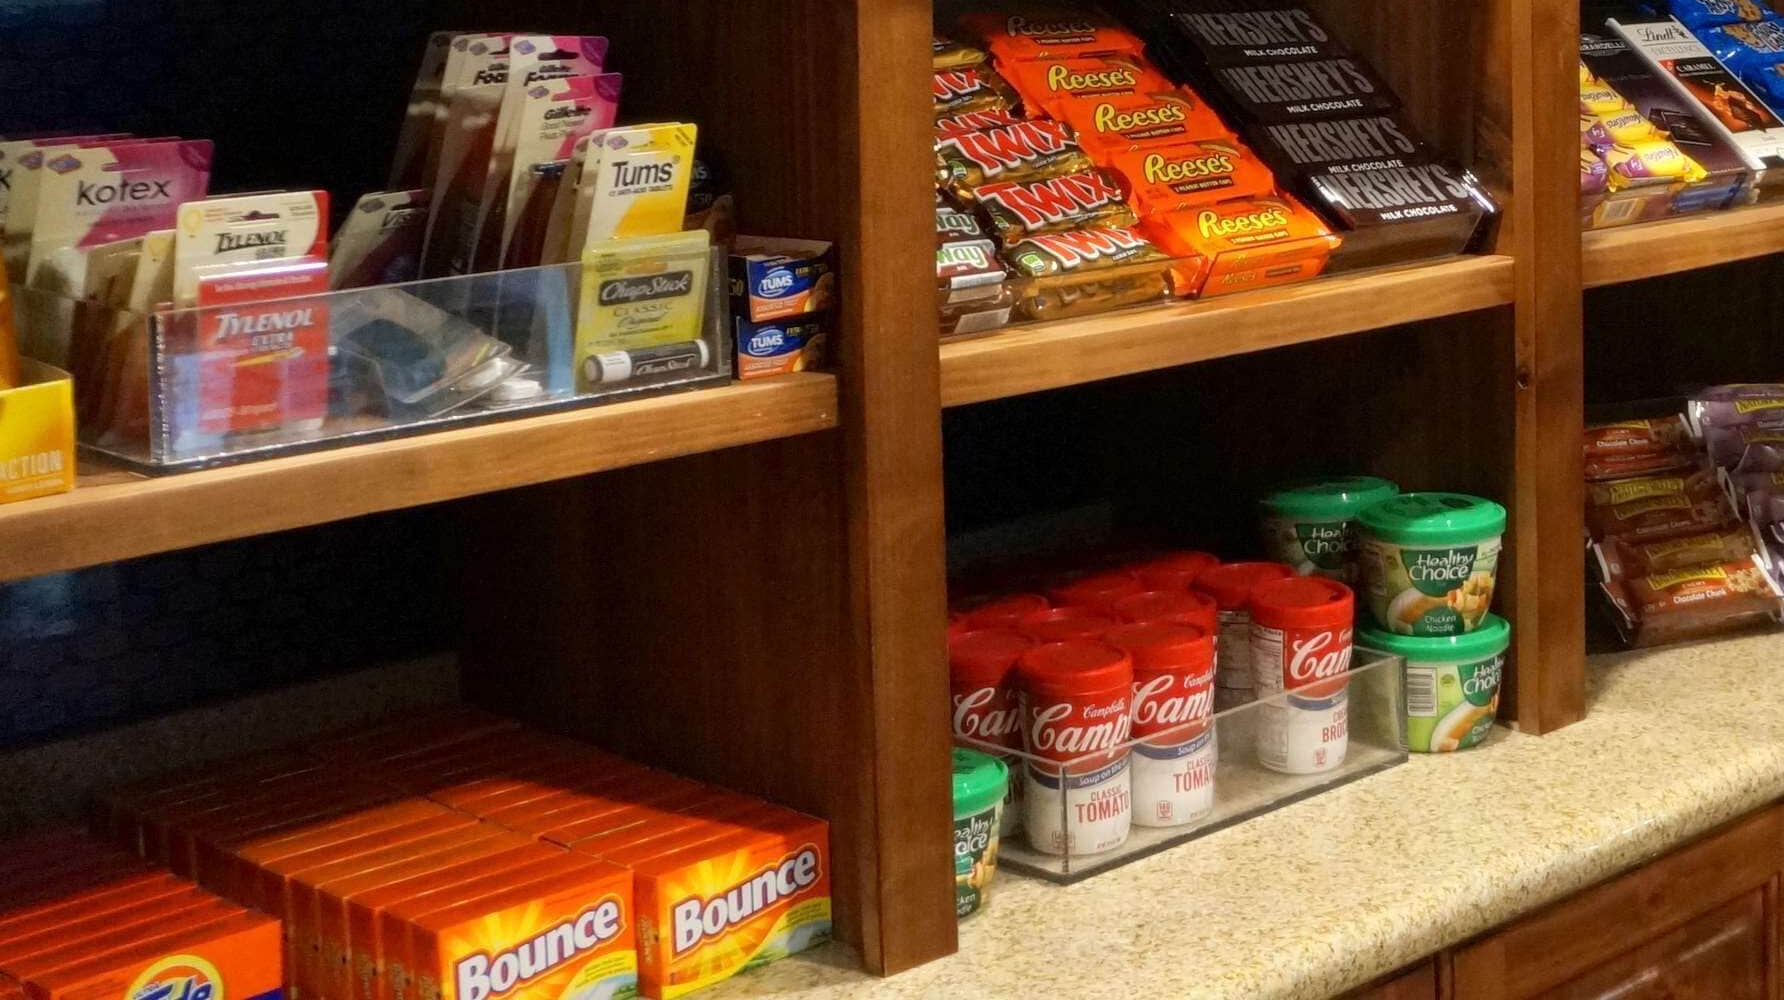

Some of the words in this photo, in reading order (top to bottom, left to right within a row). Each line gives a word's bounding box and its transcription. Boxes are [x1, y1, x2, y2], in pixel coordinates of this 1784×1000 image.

[1183, 8, 1329, 46] HERSHEY'S
[1639, 27, 1677, 42] Lindt
[1244, 47, 1266, 57] MILK
[1265, 45, 1319, 57] CHOCOLATE
[1048, 63, 1137, 92] Reese's
[1222, 58, 1375, 104] HERSHEY'S
[1675, 61, 1716, 73] CARAMEL
[1094, 102, 1186, 133] Reese's
[1286, 104, 1309, 114] MILK
[1308, 98, 1364, 112] CHOCOLATE
[936, 119, 1081, 178] TWIX
[1266, 116, 1416, 164] HERSHEY'S
[611, 161, 674, 188] Tums
[1144, 152, 1235, 185] Reese's
[1327, 164, 1350, 174] MILK
[1350, 158, 1404, 172] CHOCOLATE
[75, 179, 172, 207] kotex
[1316, 163, 1470, 210] HERSHEY'S
[973, 171, 1122, 232] TWIX
[1380, 210, 1402, 221] MILK
[1402, 204, 1458, 218] CHOCOLATE
[1198, 208, 1288, 239] Reese's
[213, 230, 289, 255] TYLENOL
[760, 274, 795, 291] TUMS
[214, 307, 315, 344] TYLENOL
[751, 334, 785, 348] TUMS
[1408, 562, 1470, 582] Choice
[1416, 550, 1474, 568] Healthy
[1079, 774, 1101, 787] Soup
[1100, 771, 1112, 781] on
[1074, 789, 1130, 825] TOMATO
[672, 849, 817, 954] Bounce
[456, 898, 619, 1000] Bounce
